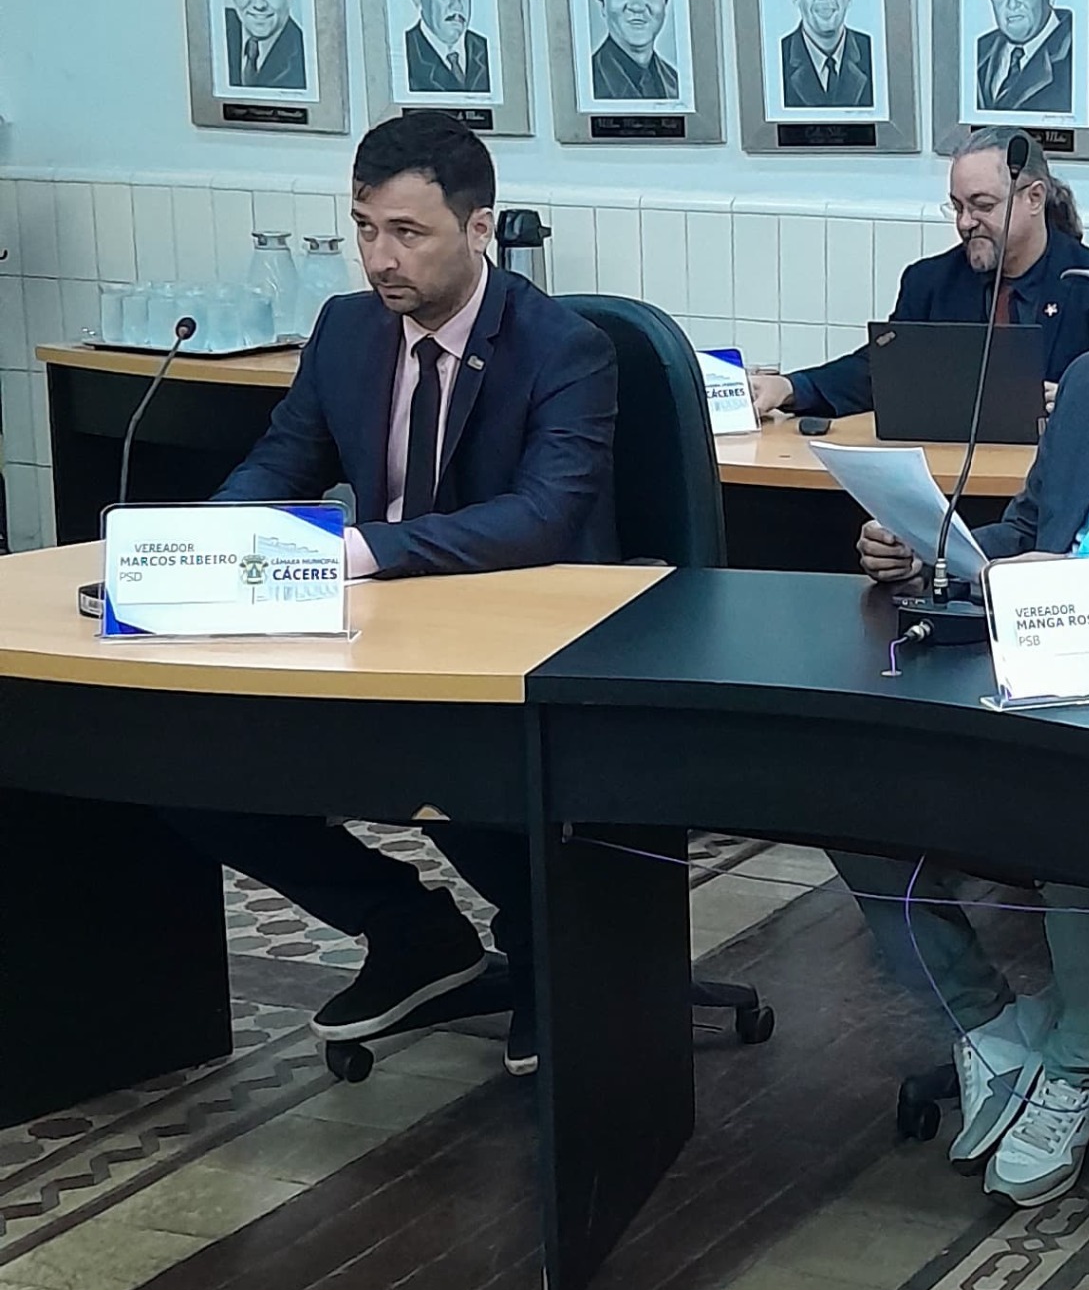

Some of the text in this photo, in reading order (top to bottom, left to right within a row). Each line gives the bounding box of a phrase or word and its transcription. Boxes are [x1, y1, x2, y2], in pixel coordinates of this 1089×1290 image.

[134, 543, 195, 554] VEREADOR
[120, 553, 237, 567] MARCOS RIBEIRO
[119, 571, 143, 582] PSD
[272, 566, 338, 581] CÁCERES
[1015, 604, 1075, 618] VEREADOR
[1016, 617, 1065, 630] MANGA
[1019, 635, 1041, 647] PSB
